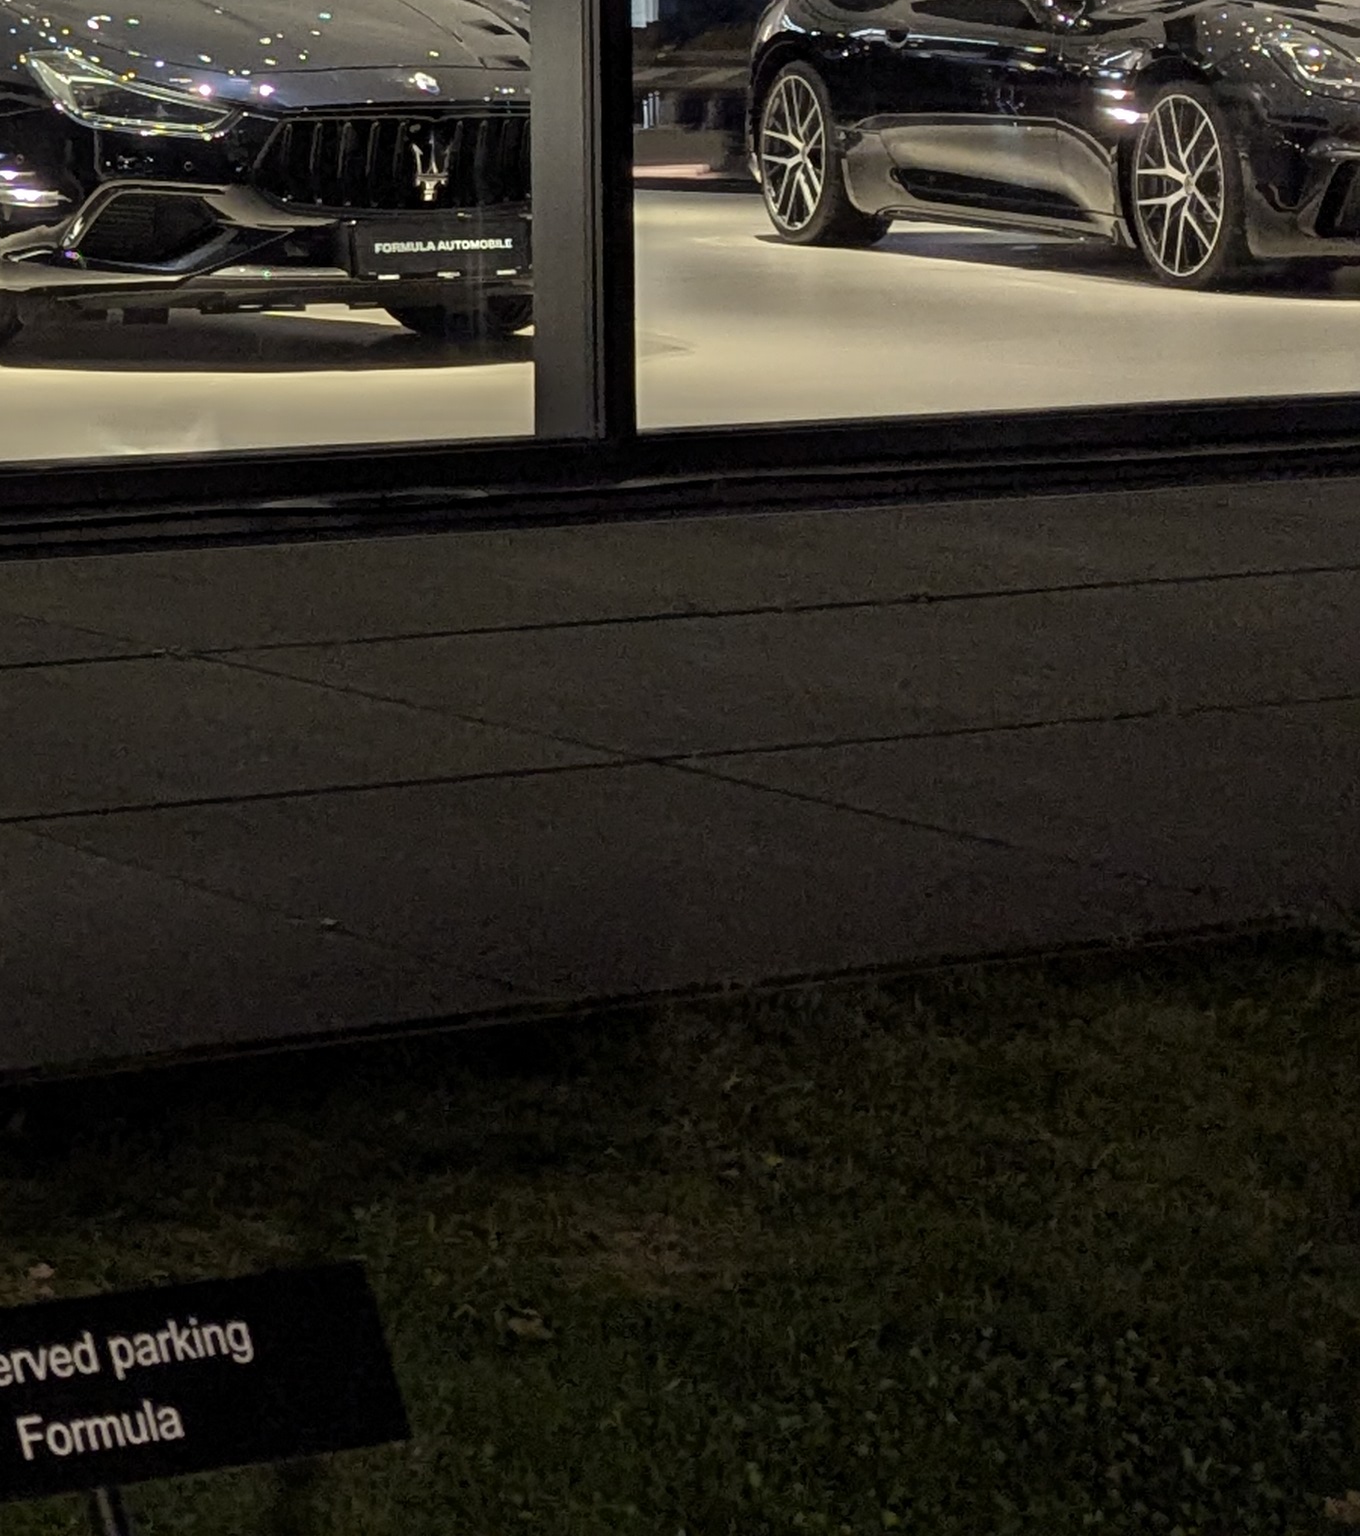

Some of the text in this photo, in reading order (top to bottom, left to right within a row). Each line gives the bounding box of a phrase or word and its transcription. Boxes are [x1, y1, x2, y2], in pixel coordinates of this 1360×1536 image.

[374, 238, 513, 254] FORMULA AUTOMOBILE
[108, 1316, 254, 1381] parking
[16, 1398, 185, 1460] Formula
